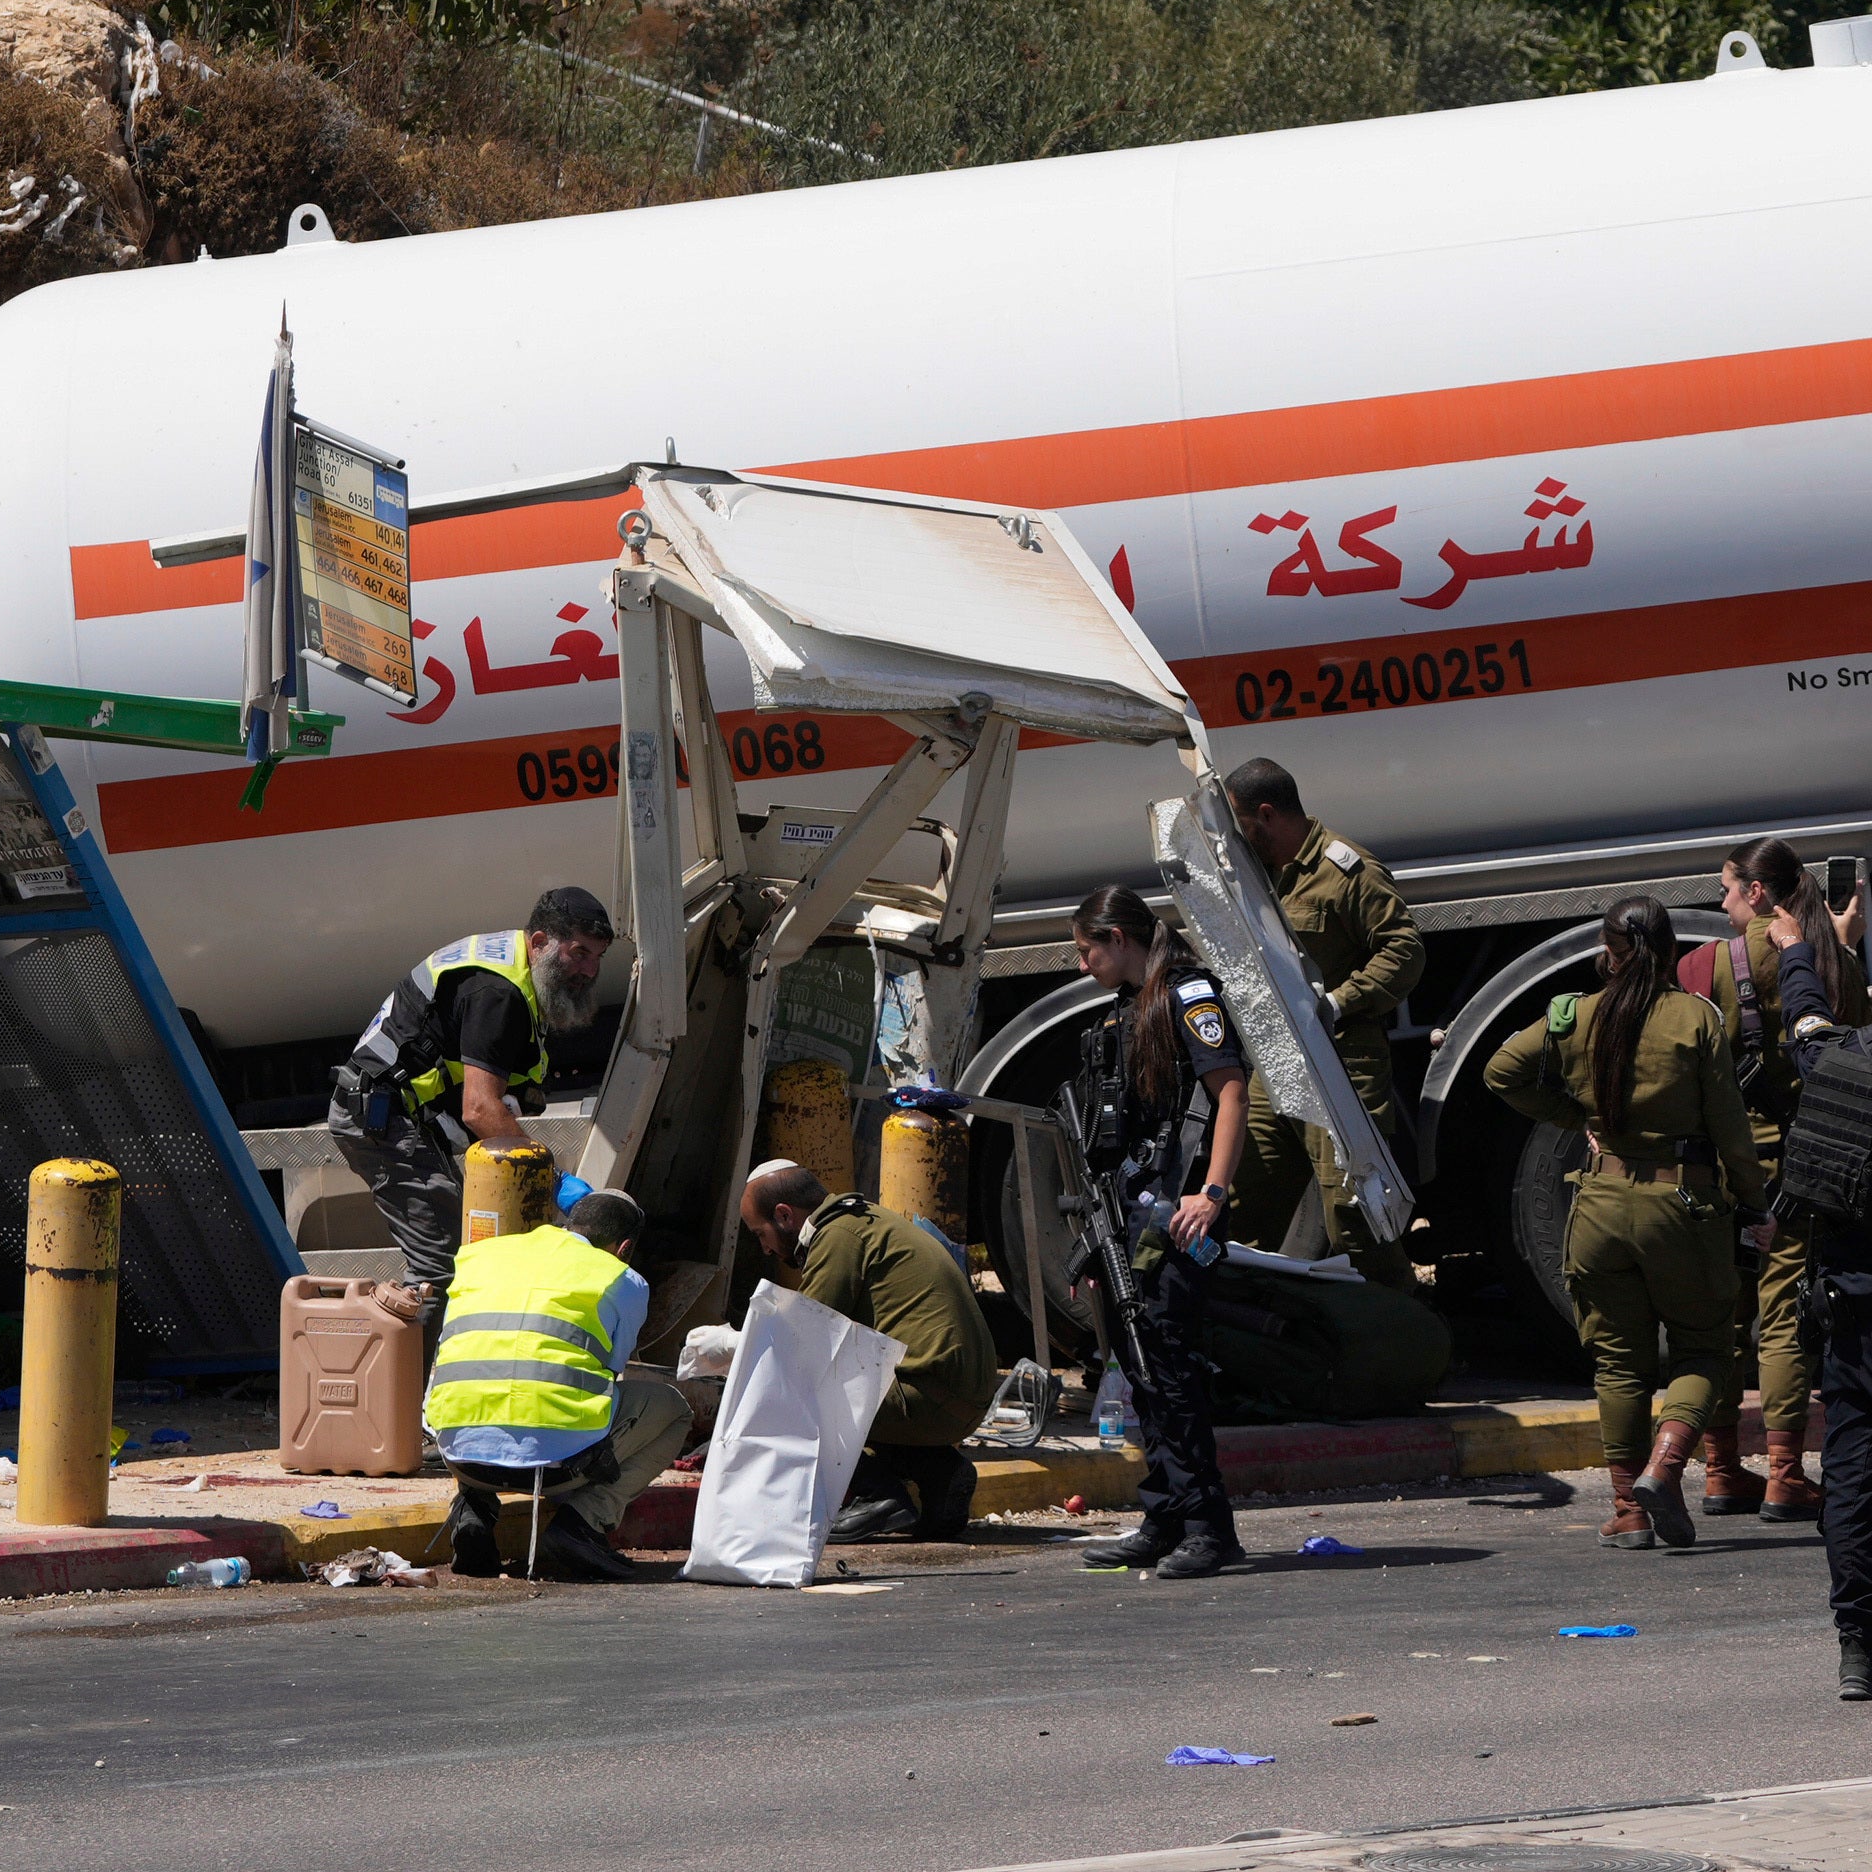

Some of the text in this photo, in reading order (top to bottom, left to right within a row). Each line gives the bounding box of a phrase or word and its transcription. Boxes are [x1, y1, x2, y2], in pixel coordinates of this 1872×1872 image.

[329, 449, 354, 468] Assaf
[298, 461, 336, 487] Road 60
[314, 498, 353, 523] Jerusalem
[348, 491, 373, 512] 61351
[316, 528, 352, 550] Jerusalem
[1247, 475, 1596, 610] شركة
[324, 608, 366, 634] Jerusalem
[383, 636, 407, 655] 269
[1234, 638, 1534, 722] 02-2400251
[1786, 668, 1827, 693] No
[320, 1384, 353, 1399] WATER
